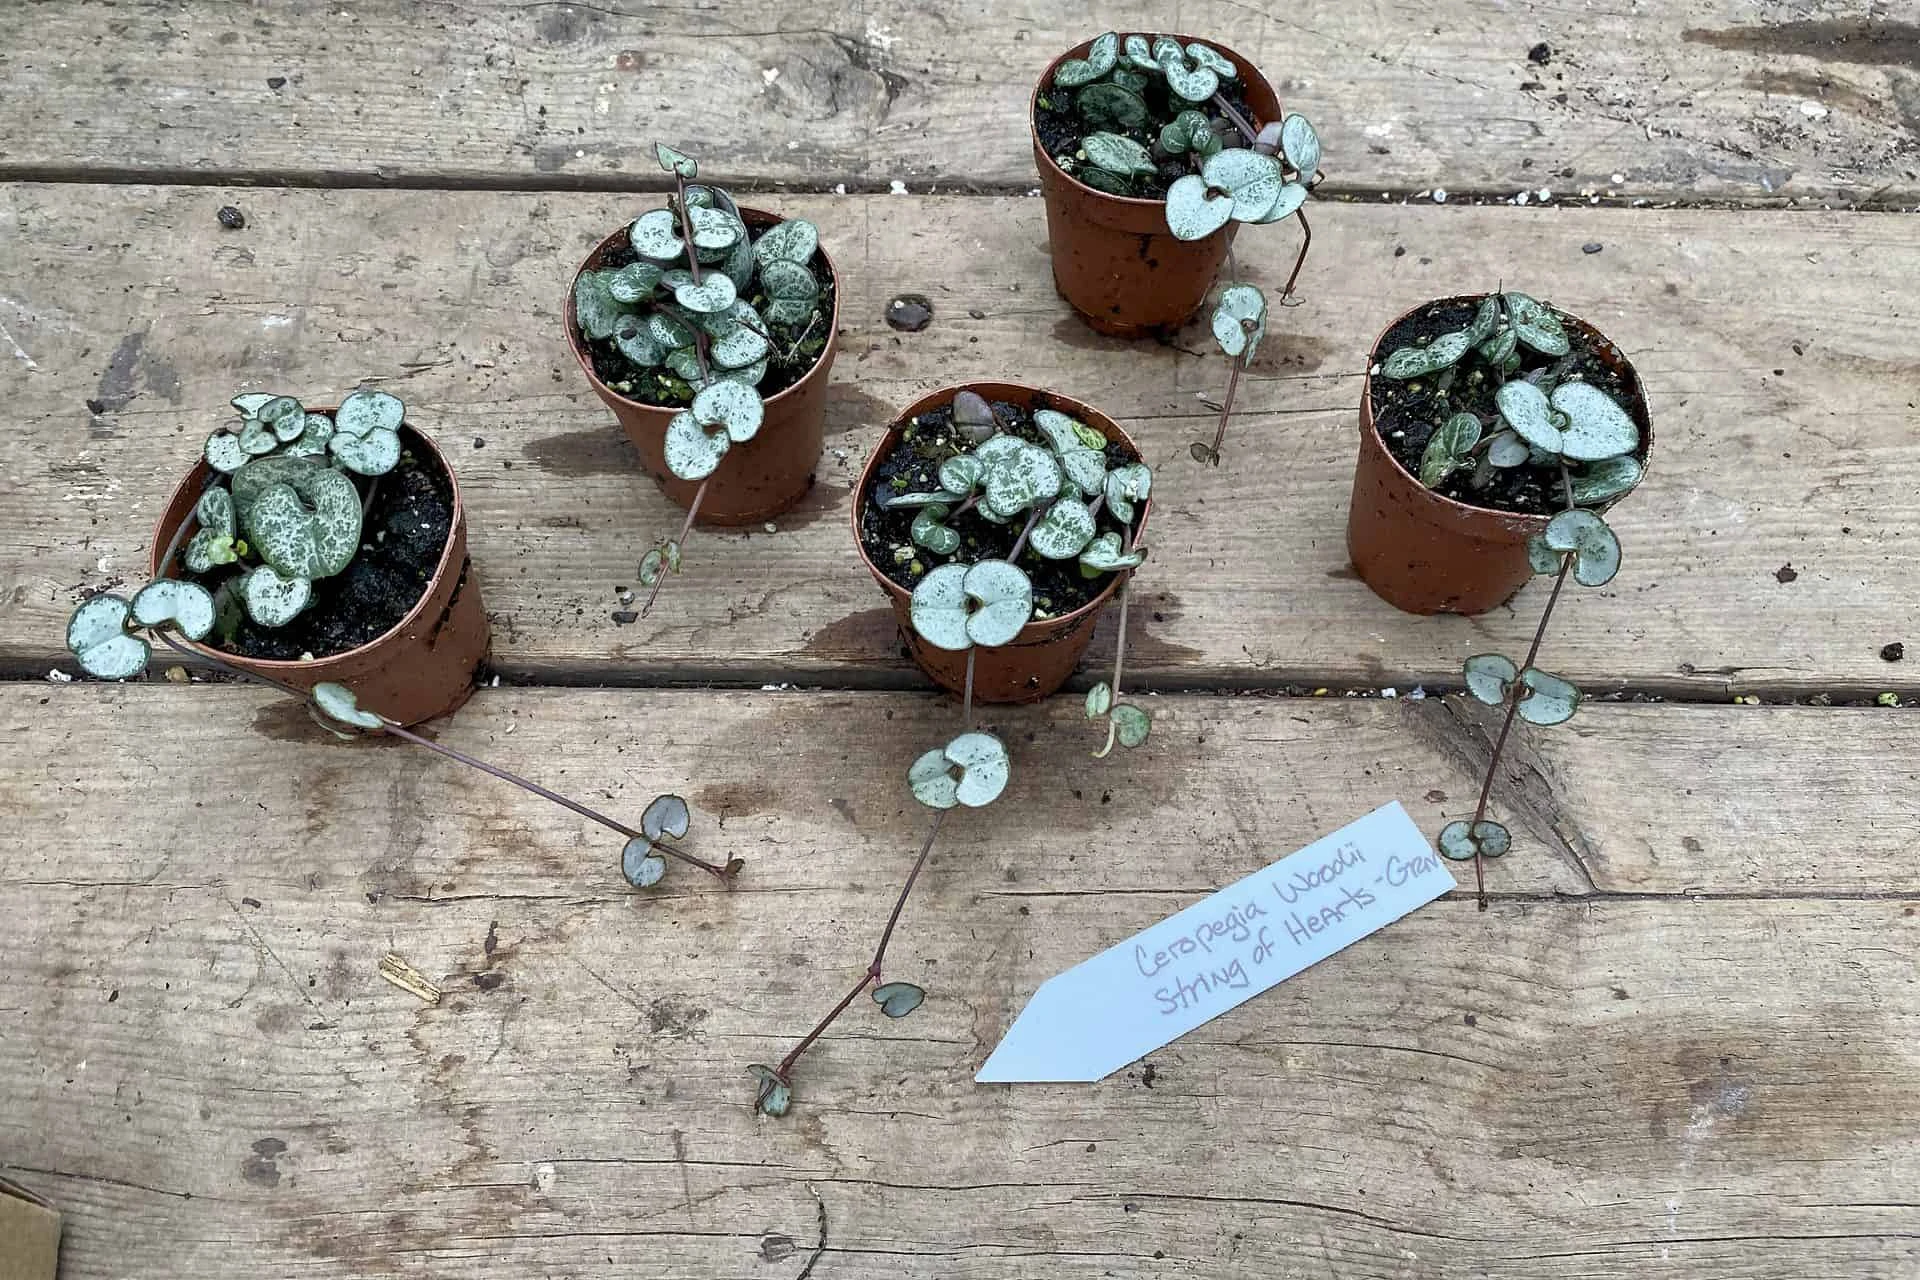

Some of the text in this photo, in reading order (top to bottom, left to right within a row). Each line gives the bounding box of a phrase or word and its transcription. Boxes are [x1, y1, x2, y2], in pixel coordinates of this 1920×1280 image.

[1136, 842, 1367, 977] Ceropegia Woodii
[1155, 958, 1250, 1015] String
[1253, 925, 1275, 965] of
